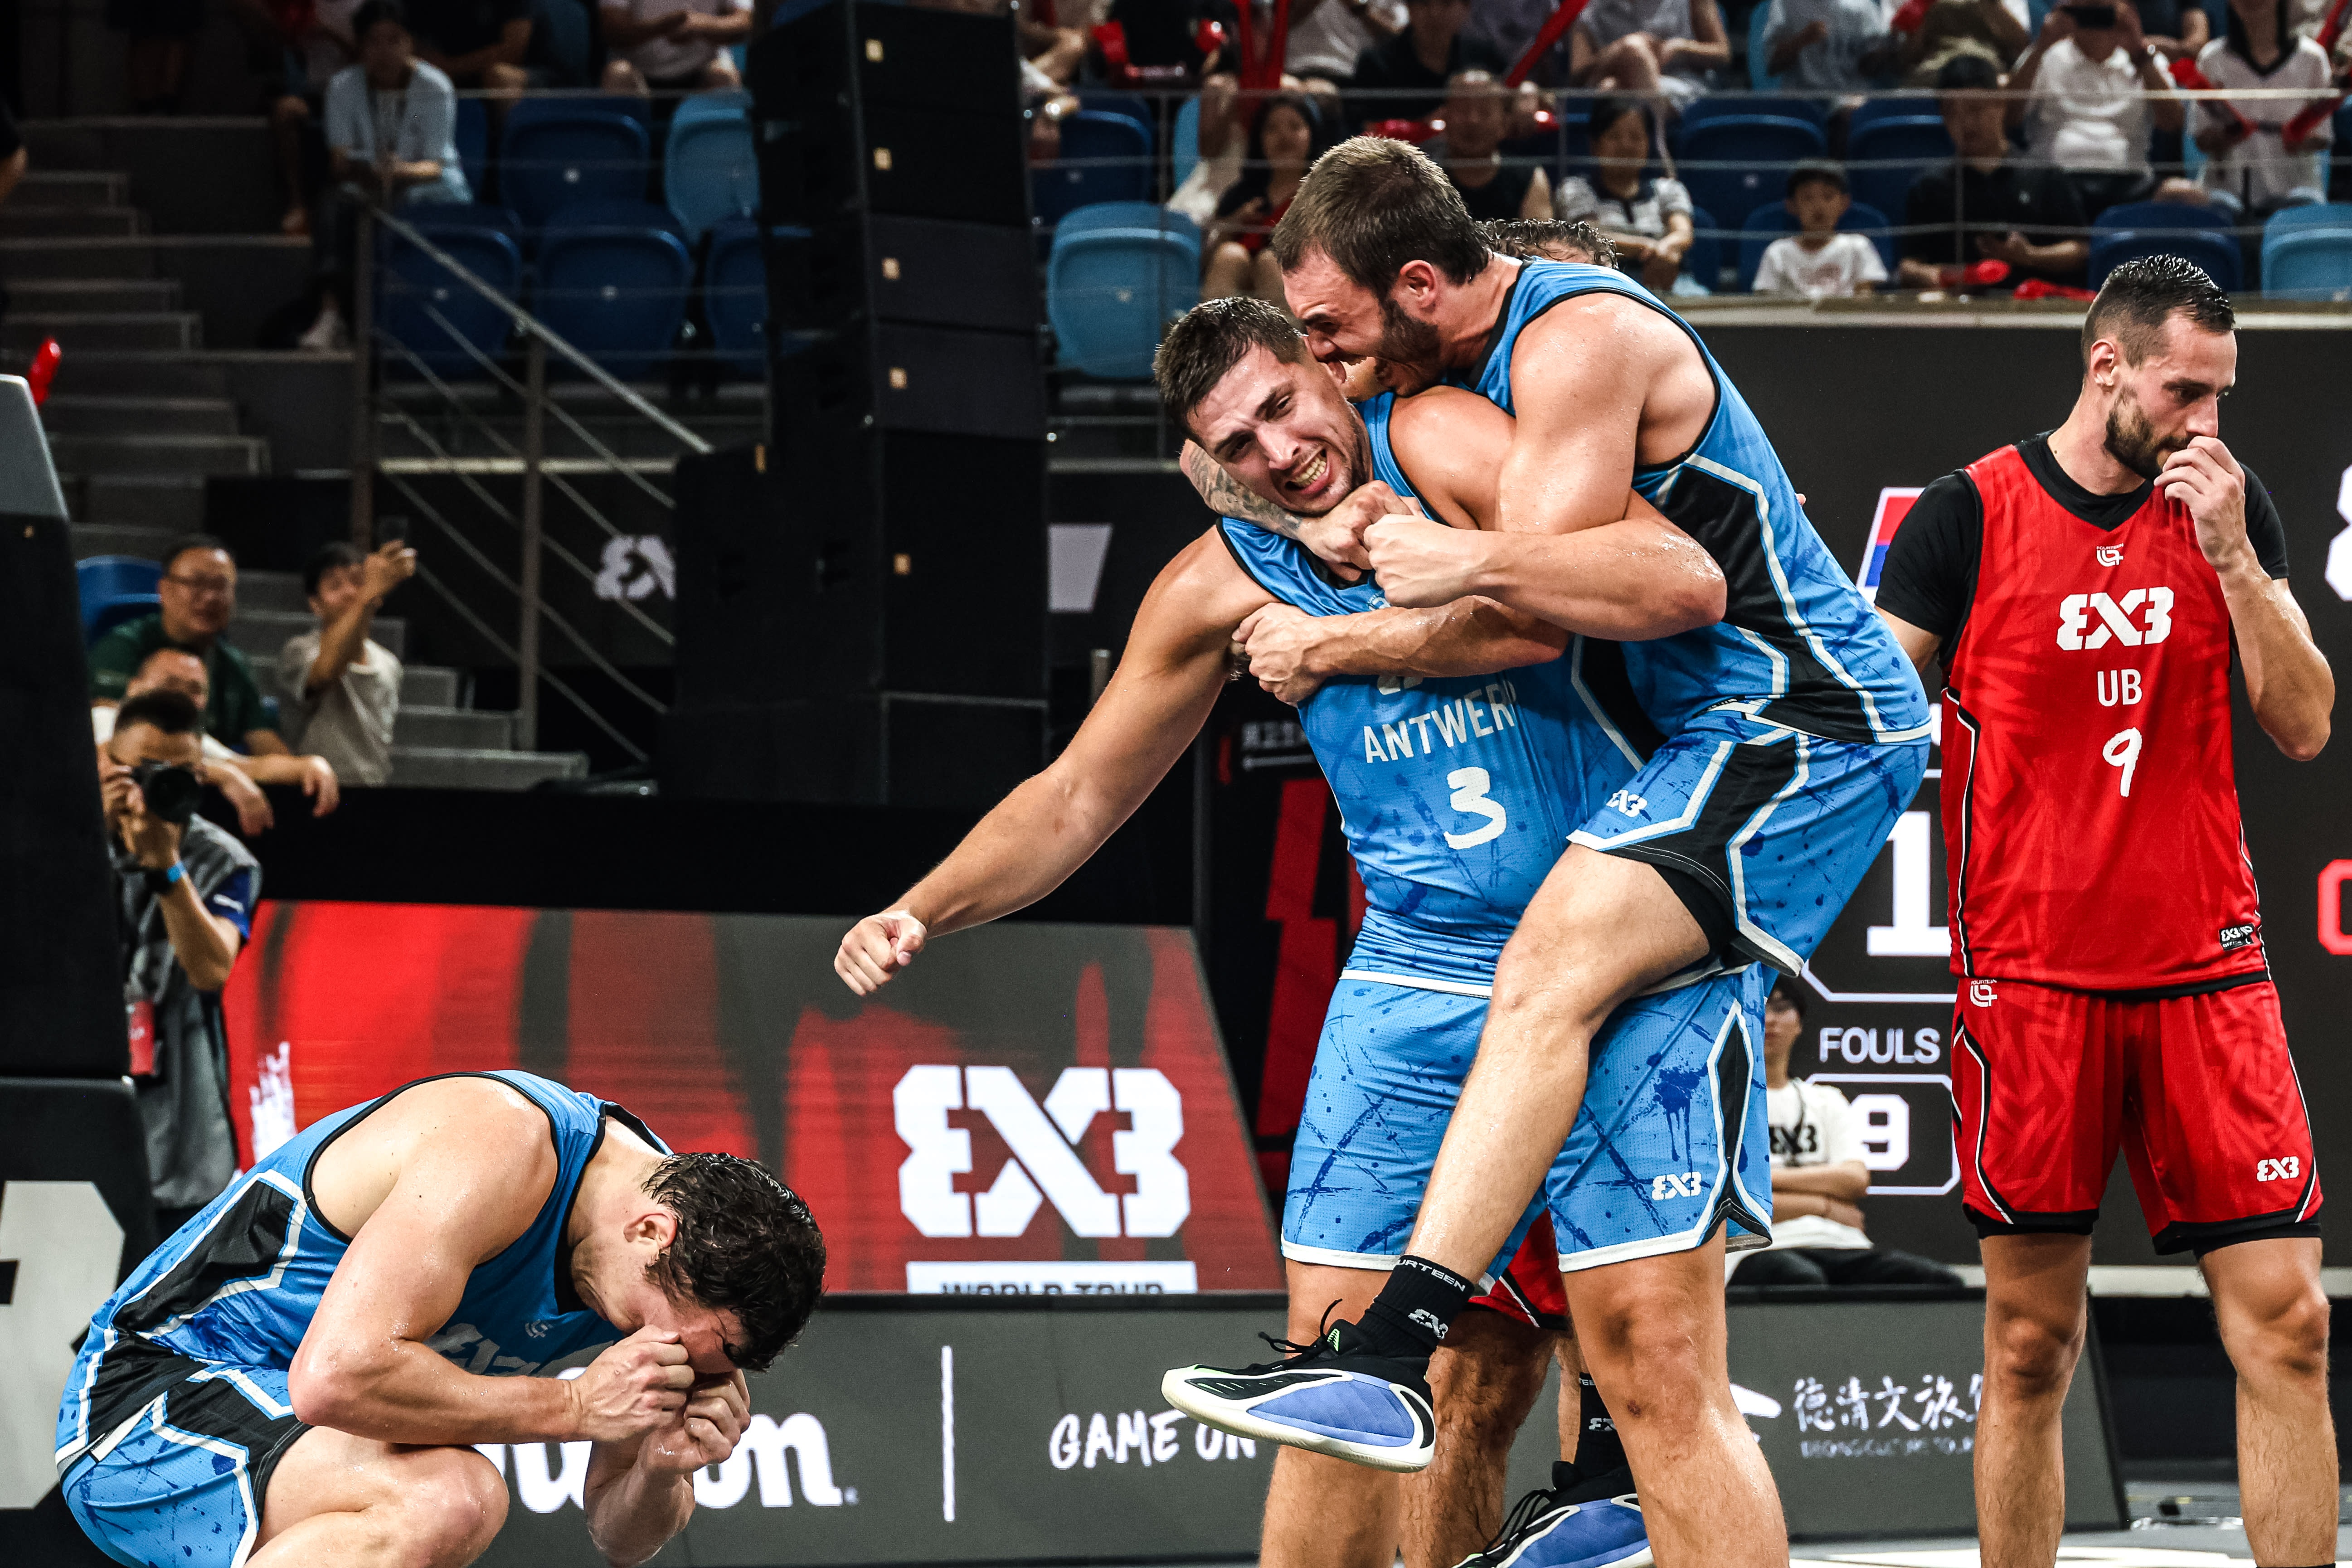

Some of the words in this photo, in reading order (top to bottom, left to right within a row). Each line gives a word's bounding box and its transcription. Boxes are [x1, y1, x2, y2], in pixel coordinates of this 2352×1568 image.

[2096, 669, 2143, 707] UB
[2102, 727, 2143, 797] 9
[1443, 766, 1507, 850] 3
[1818, 1026, 1941, 1064] FOULS
[1396, 1259, 1466, 1292] URTEEN
[1793, 1374, 1983, 1432] 德清文旅
[1049, 1409, 1187, 1470] GAME
